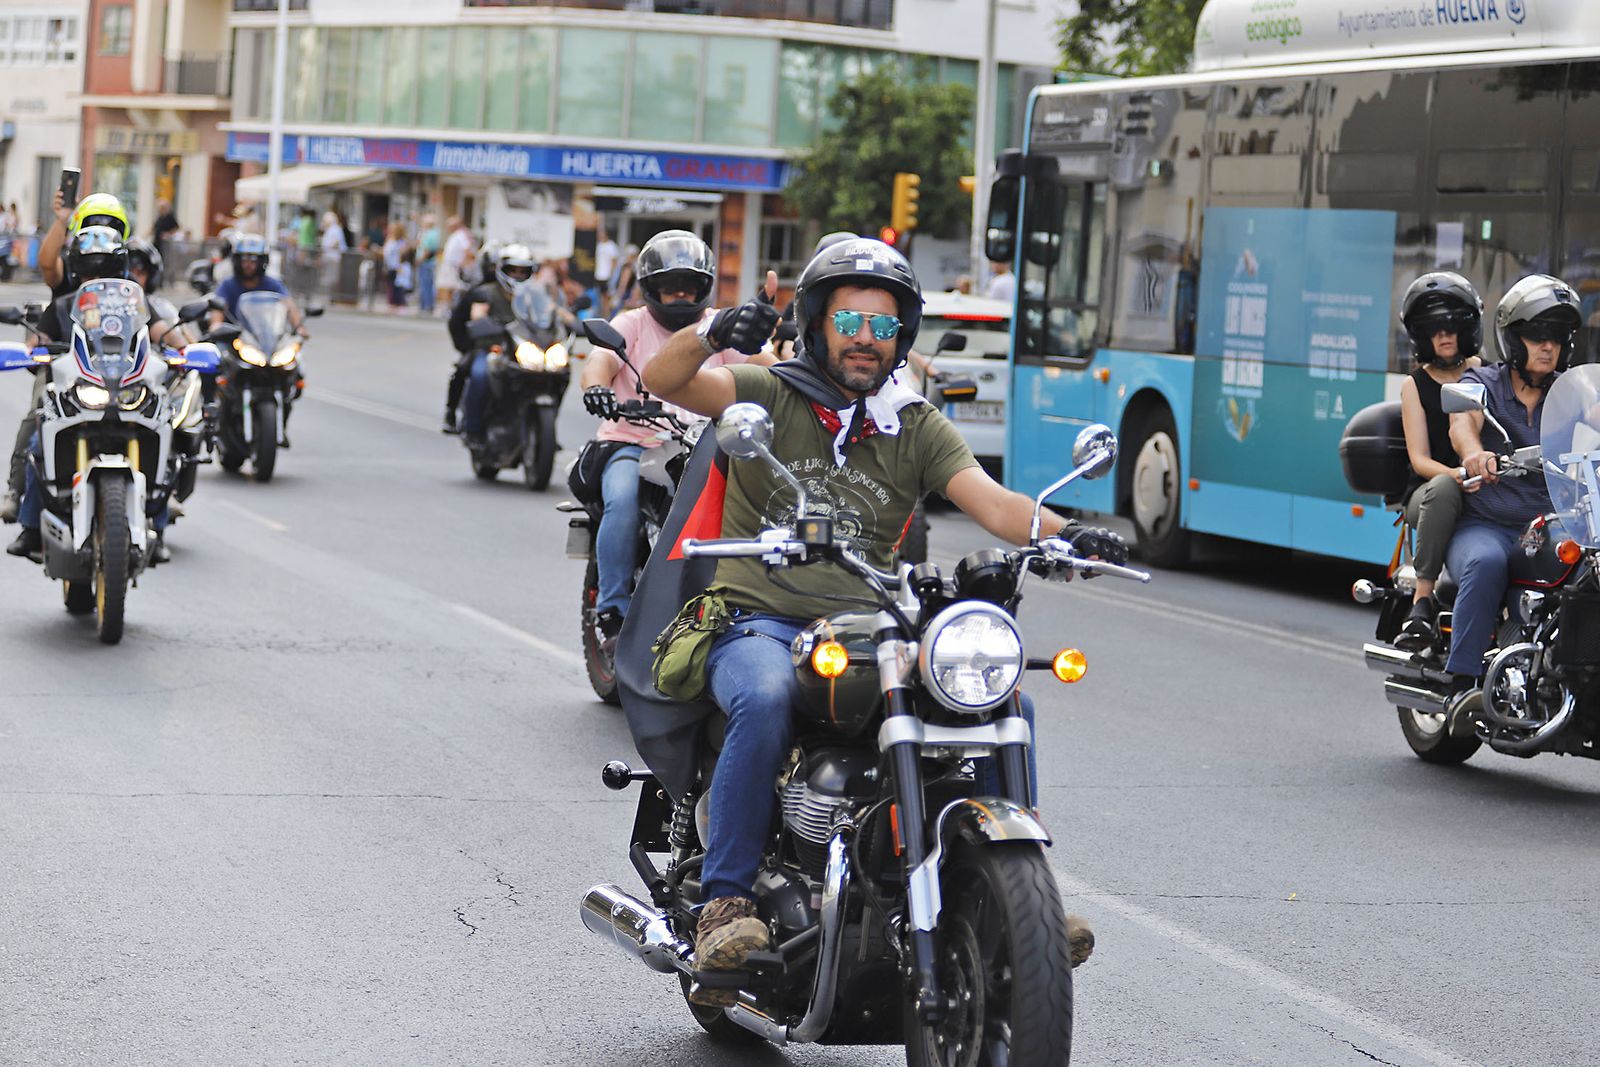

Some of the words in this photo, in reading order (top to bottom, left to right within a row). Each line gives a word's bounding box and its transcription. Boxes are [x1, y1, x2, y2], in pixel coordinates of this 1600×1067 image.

[1246, 15, 1301, 44] ecológico
[1337, 8, 1417, 38] Ayuntamiento
[1418, 3, 1435, 27] de
[1436, 0, 1499, 24] HUELVA
[433, 141, 530, 175] Inmobiliaria
[561, 151, 662, 179] HUERTA
[664, 157, 768, 184] GRANDE
[848, 470, 878, 493] SINCE
[875, 486, 891, 507] 1901
